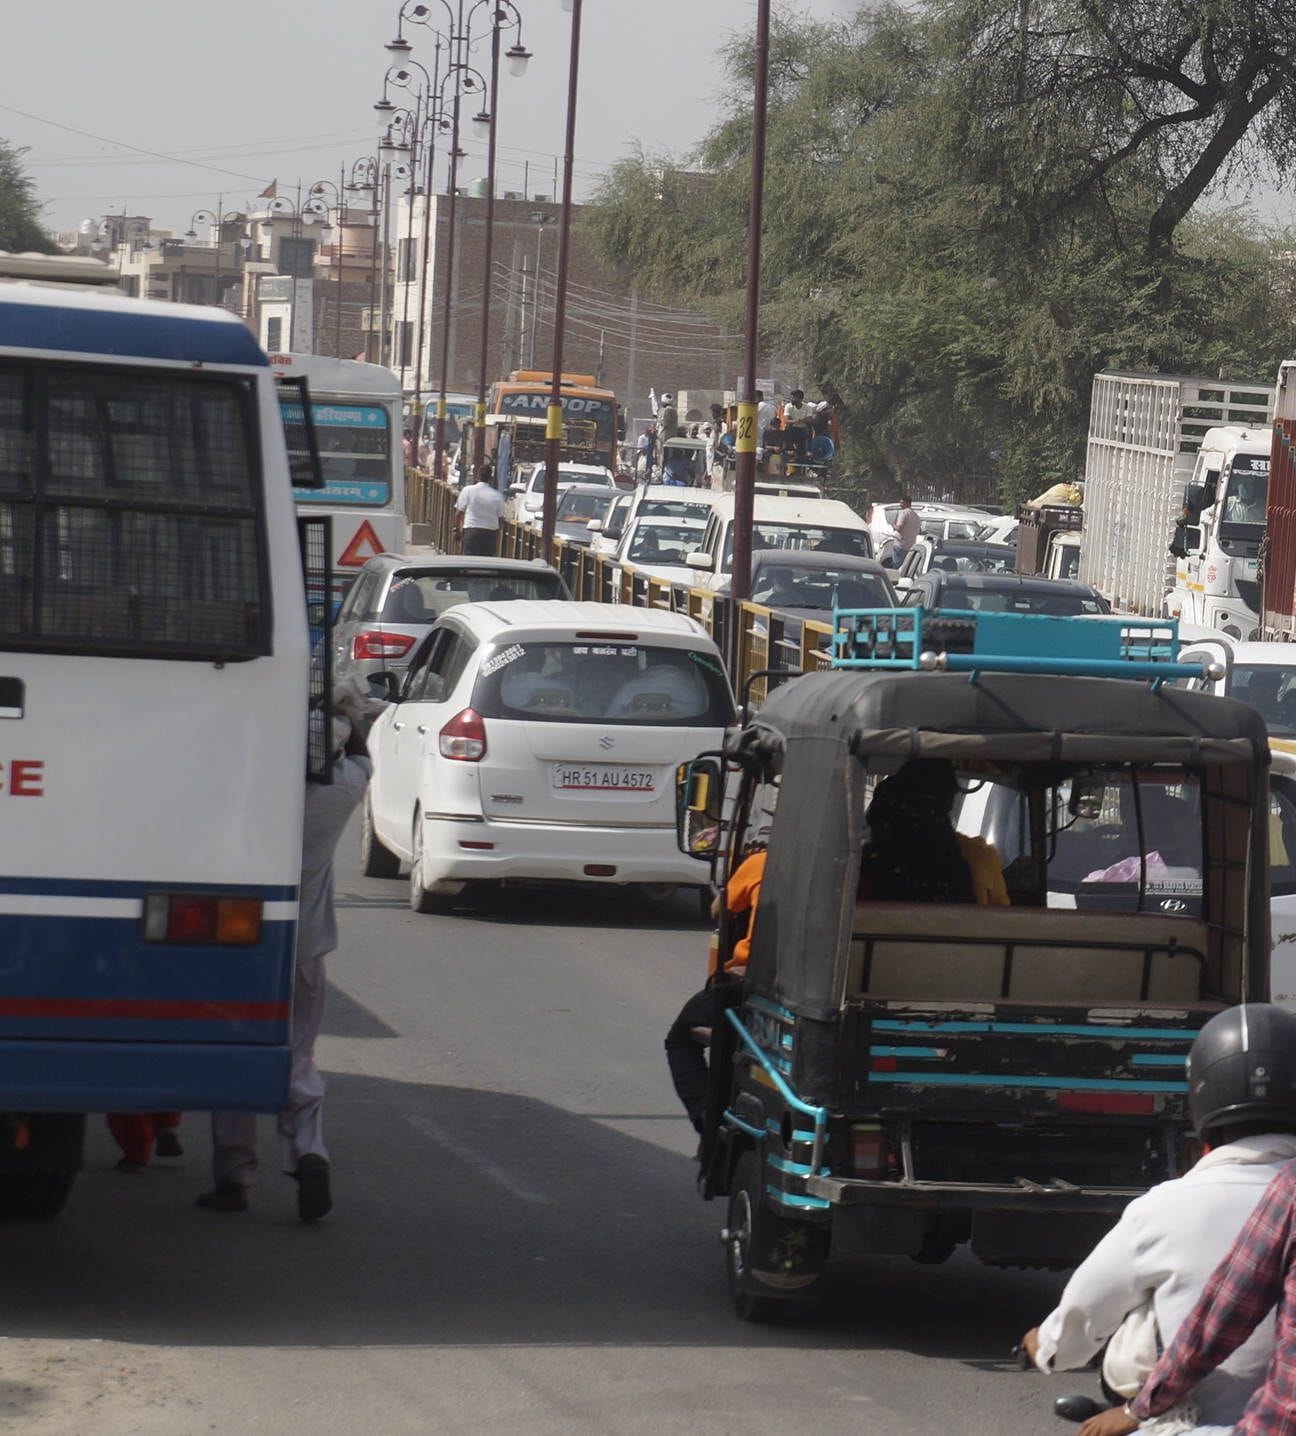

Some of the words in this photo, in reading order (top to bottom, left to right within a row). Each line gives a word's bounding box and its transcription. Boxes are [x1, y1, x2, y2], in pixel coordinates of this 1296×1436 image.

[738, 415, 753, 439] 32
[0, 760, 45, 797] E
[562, 770, 582, 785] HR
[583, 771, 598, 786] 51
[602, 772, 620, 787] AU
[622, 773, 653, 788] 4572
